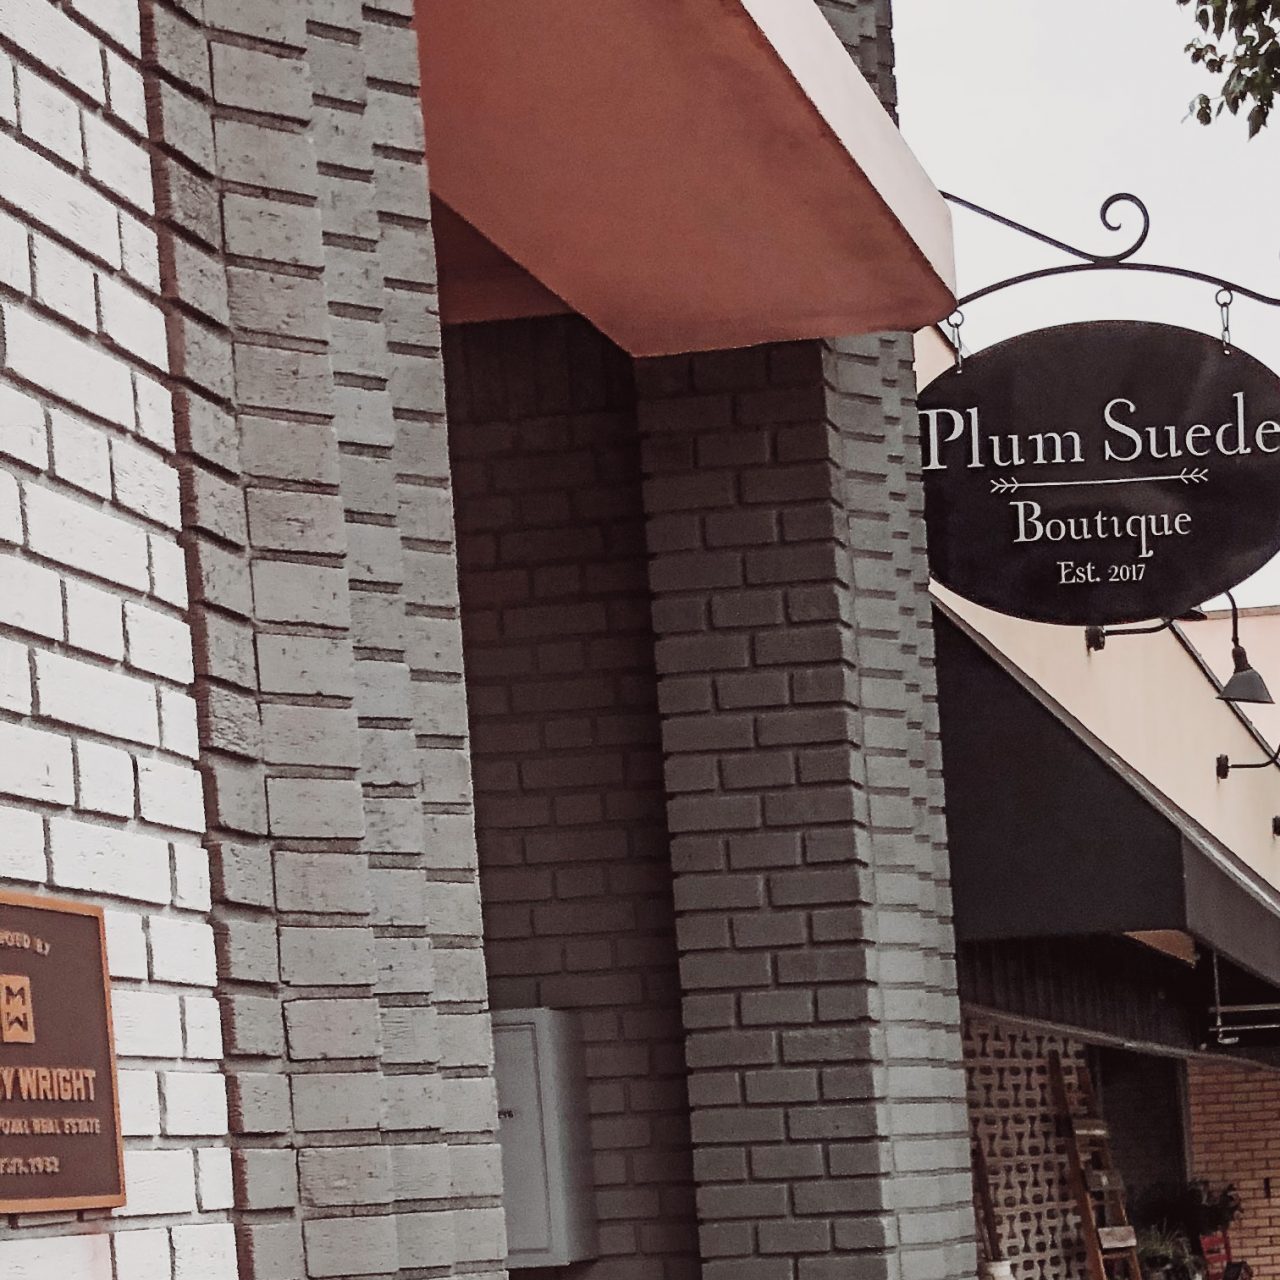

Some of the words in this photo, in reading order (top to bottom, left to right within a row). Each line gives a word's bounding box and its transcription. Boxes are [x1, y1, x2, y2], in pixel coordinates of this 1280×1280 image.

[919, 407, 1085, 471] Plum
[1009, 501, 1192, 559] Boutique
[1056, 561, 1100, 585] Est.
[1109, 563, 1146, 582] 2017
[18, 1066, 96, 1101] WRIGHT
[62, 1118, 101, 1134] ESTATE
